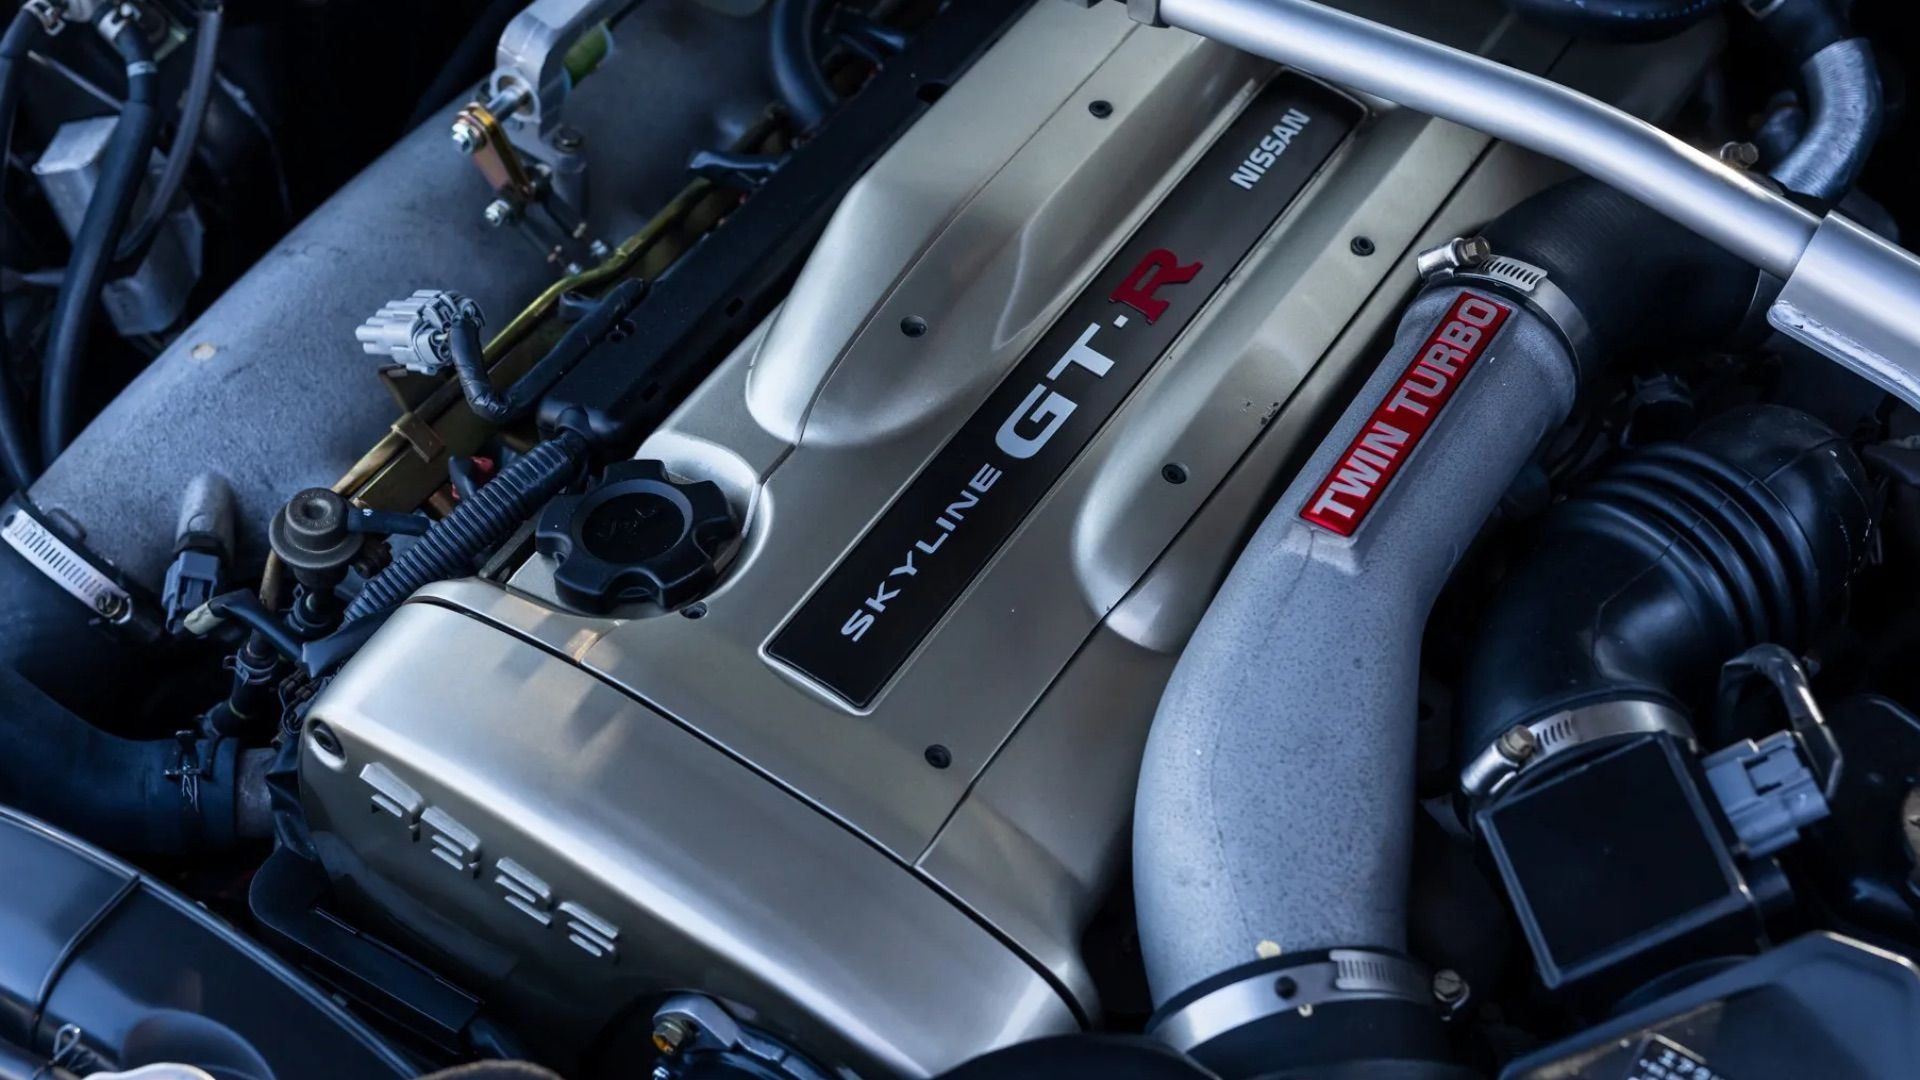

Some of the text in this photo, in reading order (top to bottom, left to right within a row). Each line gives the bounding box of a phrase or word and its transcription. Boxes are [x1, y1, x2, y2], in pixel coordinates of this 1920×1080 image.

[1230, 108, 1310, 190] NISSAN
[1310, 298, 1498, 519] TWIN TURBO
[840, 463, 1003, 642] SKYLINE
[359, 761, 620, 958] RB26
